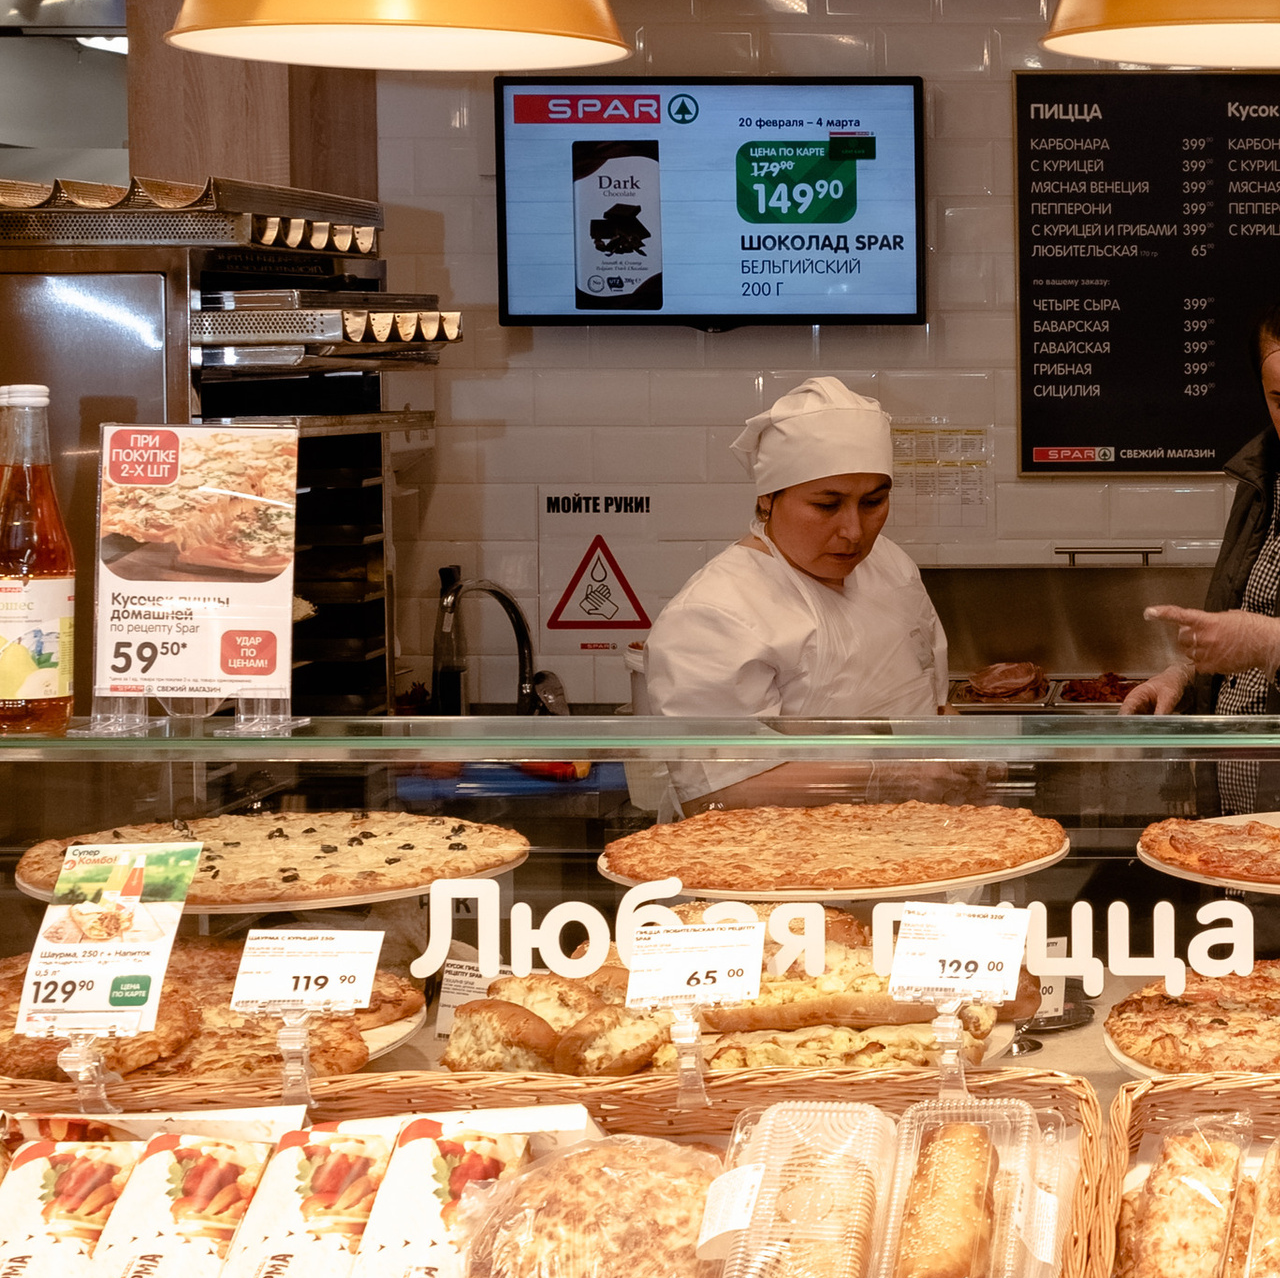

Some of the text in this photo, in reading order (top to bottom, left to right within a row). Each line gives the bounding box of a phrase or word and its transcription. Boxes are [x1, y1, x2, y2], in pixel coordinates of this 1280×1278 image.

[548, 99, 658, 119] SPAR
[1030, 104, 1102, 122] ПИЦЦА
[1228, 102, 1280, 121] Кусок
[739, 118, 860, 129] 20 февраля 4 марта
[1030, 138, 1110, 150] КАРБОНАРА
[750, 148, 824, 157] ЦЕНА ПО КАРТЕ
[1030, 159, 1104, 174] С КУРИЦЕЙ
[1228, 160, 1238, 172] С
[598, 176, 640, 190] Dark
[1031, 182, 1149, 195] МЯСНАЯ ВЕНЕЦИЯ
[1031, 203, 1112, 214] ПЕППЕРОНИ
[1032, 223, 1177, 238] С КУРИЦЕЙ И ГРИБАМИ
[1229, 224, 1238, 236] С
[741, 235, 904, 253] ШОКОЛАД SPAR
[1032, 245, 1138, 256] ЛЮБИТЕЛЬСКАЯ
[742, 258, 861, 274] БЕЛЬГИЙСКИЙ
[742, 282, 784, 296] 200 Г
[1046, 279, 1078, 287] вашему
[1081, 279, 1110, 287] заказу:
[1033, 299, 1120, 311] ЧЕТЫРЕ СЫРА
[1034, 320, 1110, 332] БАВАРСКАЯ
[1034, 340, 1110, 354] ГАВАЙСКАЯ
[1034, 363, 1092, 375] ГРИБНАЯ
[1034, 385, 1100, 399] СИЦИЛИЯ
[130, 434, 160, 448] ПРИ
[112, 449, 176, 462] ПОКУПКЕ
[1048, 450, 1094, 458] SPAR
[1120, 448, 1215, 458] СВЕЖИЙ МАГАЗИН
[120, 464, 170, 478] 2-Х ШТ
[546, 493, 650, 514] МОЙТЕ РУКИ!
[110, 608, 194, 621] домашней
[110, 623, 200, 635] по рецепту Spar
[236, 636, 262, 646] УДАР
[241, 648, 256, 656] ПО
[228, 659, 268, 668] ЦЕНАМ!
[156, 684, 186, 692] СВЕЖИЙ
[72, 849, 100, 858] Супер
[78, 856, 118, 865] Комбо!
[987, 961, 1004, 972] 00
[292, 974, 356, 992] 119 90
[686, 968, 744, 987] 65 00
[125, 990, 147, 998] КАРТЕ
